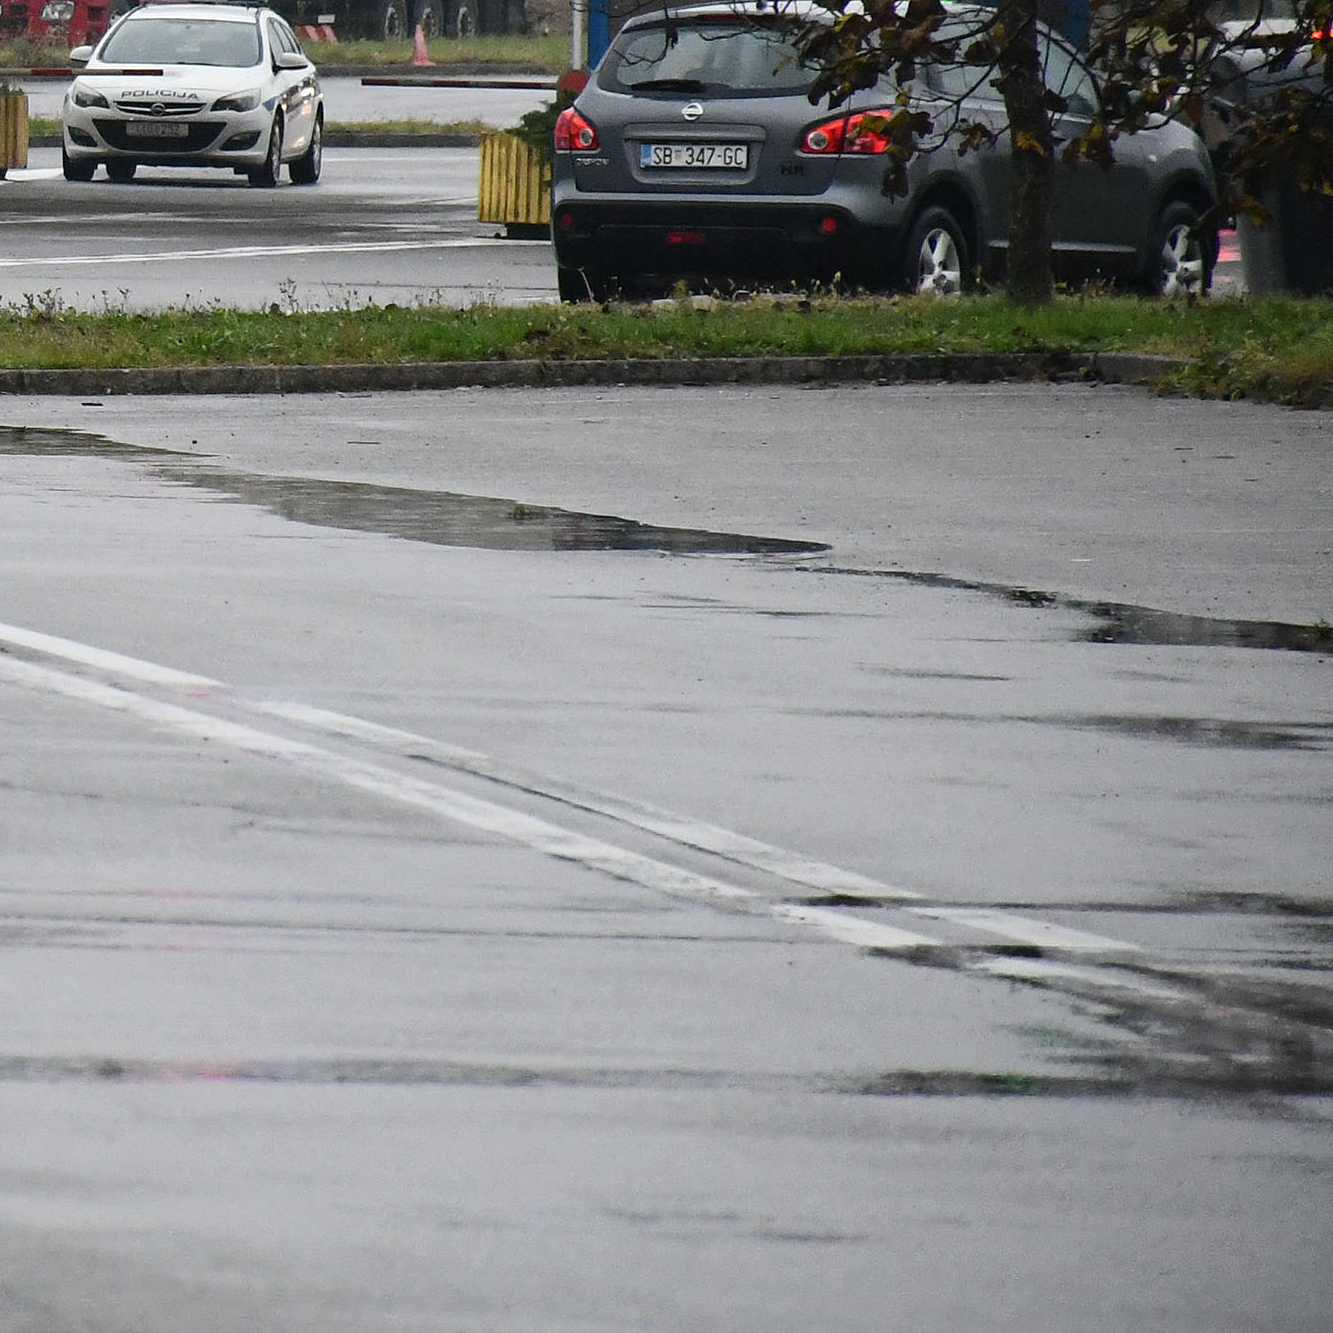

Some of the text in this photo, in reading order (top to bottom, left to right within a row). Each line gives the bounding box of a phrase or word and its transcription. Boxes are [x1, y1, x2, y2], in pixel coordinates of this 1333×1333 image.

[121, 89, 199, 101] POLICIJA
[652, 147, 744, 165] SB 347-GC
